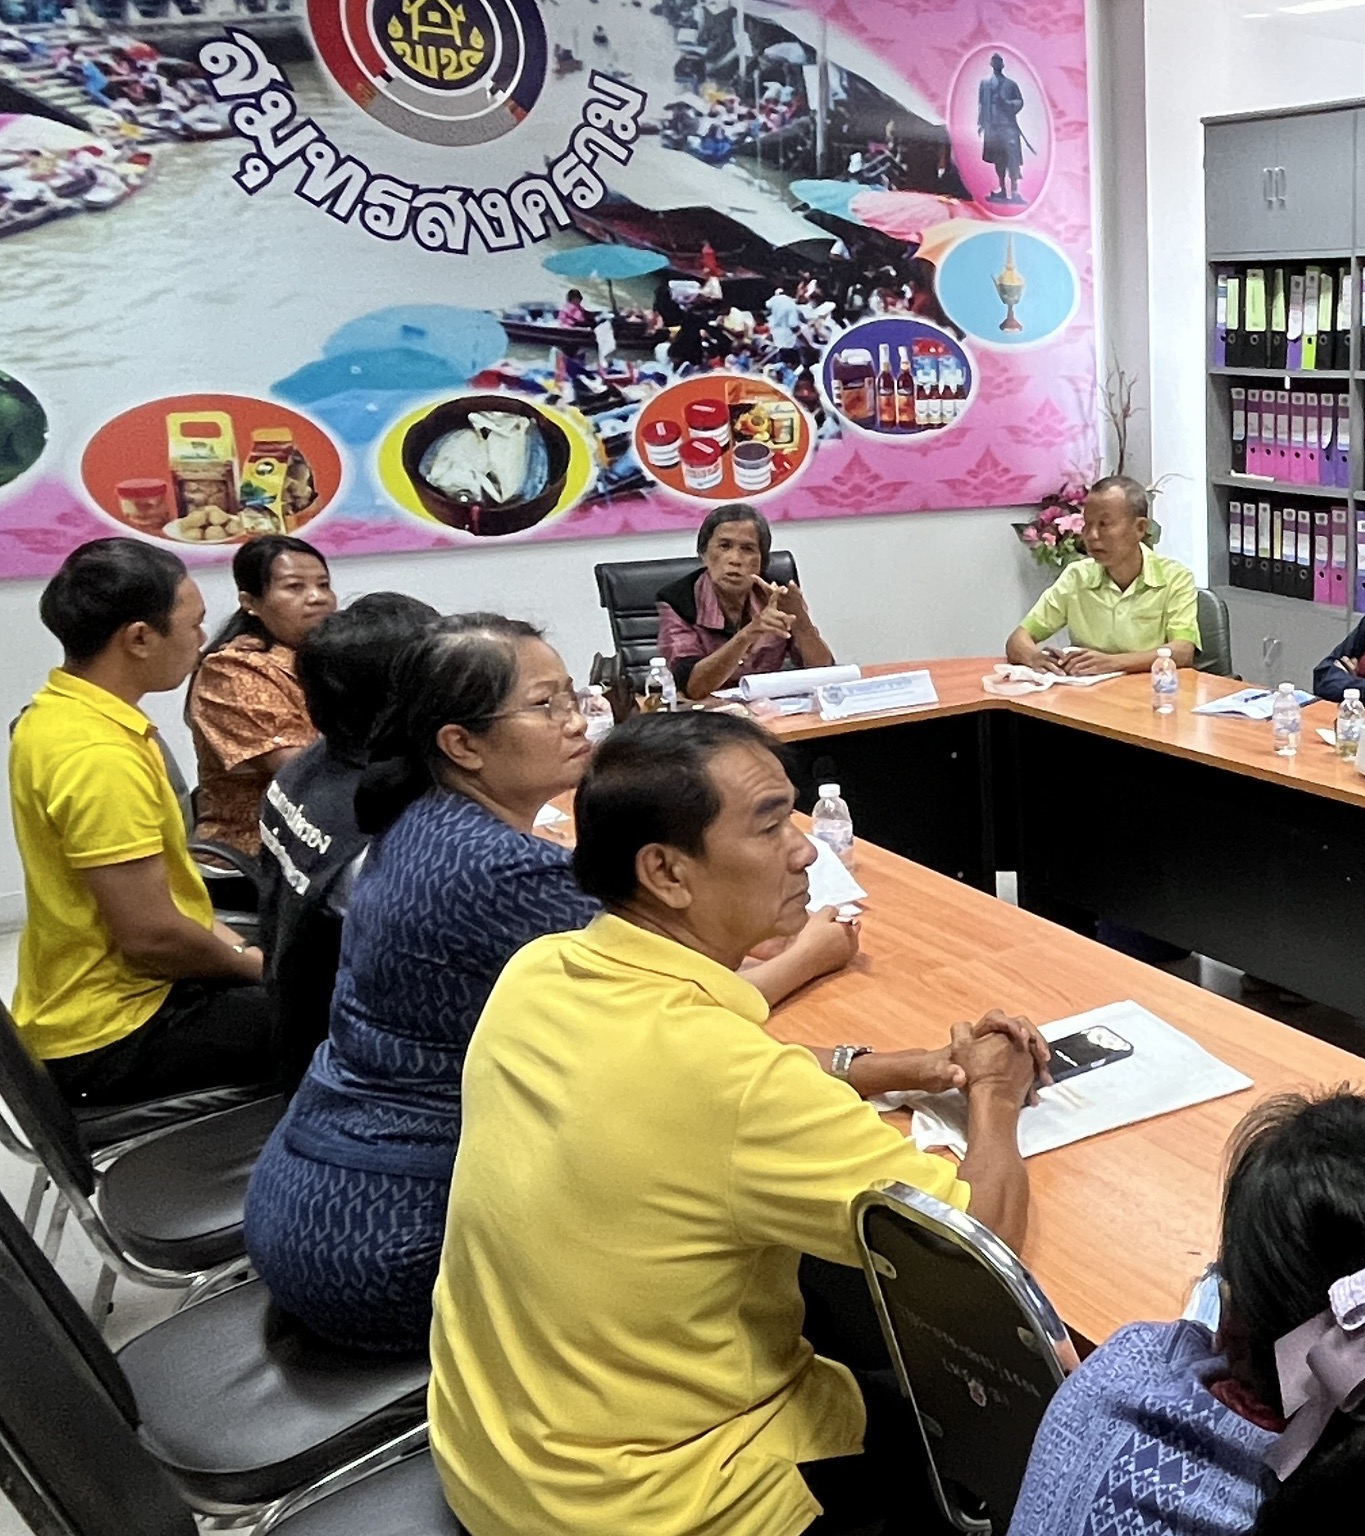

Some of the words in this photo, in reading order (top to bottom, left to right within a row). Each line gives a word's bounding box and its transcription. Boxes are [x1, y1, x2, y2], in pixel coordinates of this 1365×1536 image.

[199, 27, 648, 254] สมุทรสงคราม
